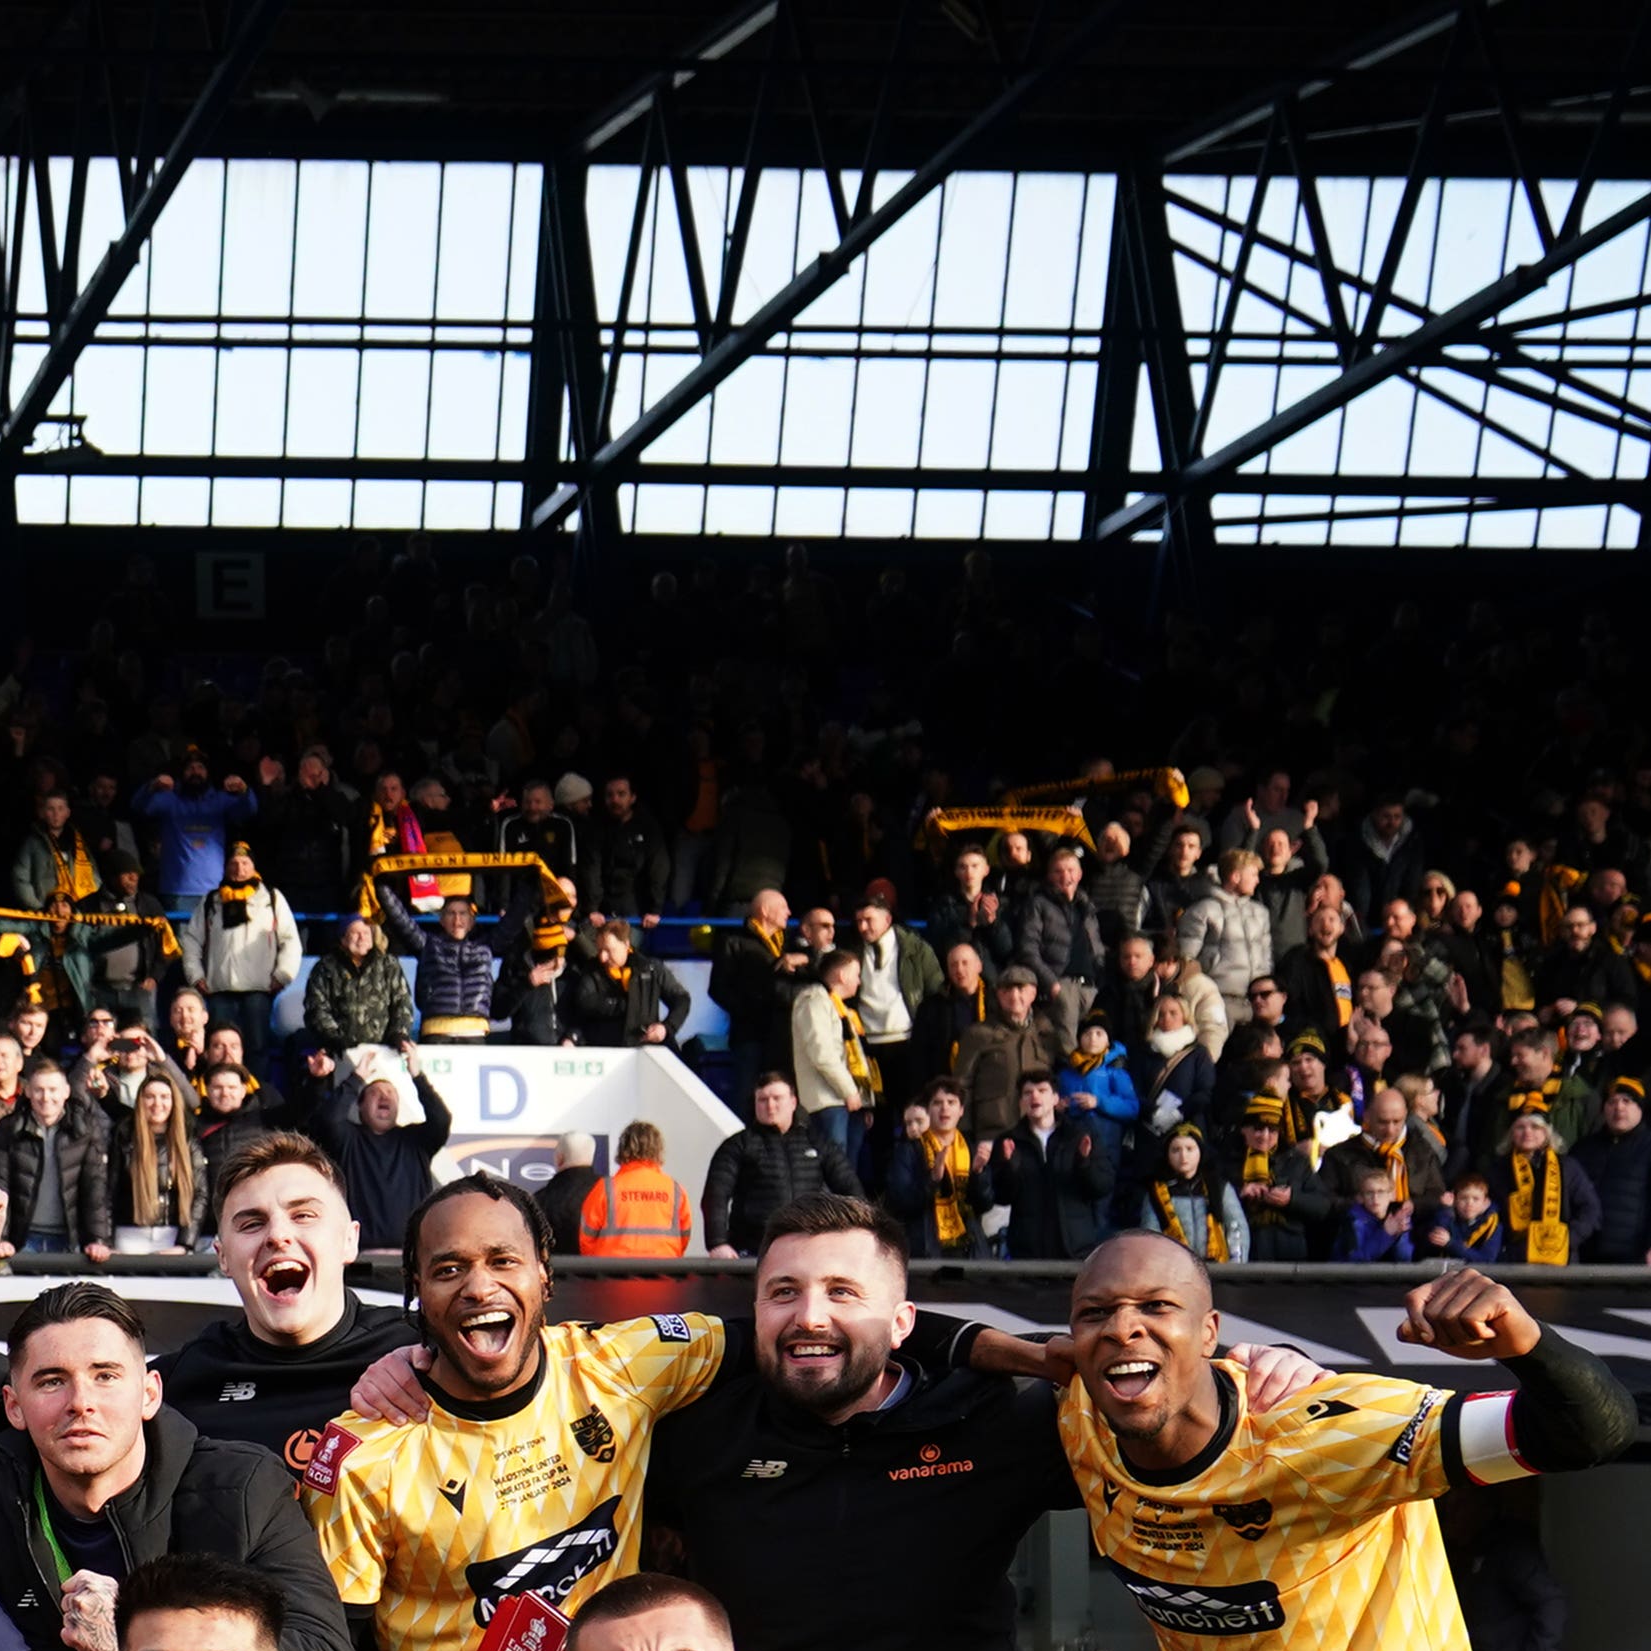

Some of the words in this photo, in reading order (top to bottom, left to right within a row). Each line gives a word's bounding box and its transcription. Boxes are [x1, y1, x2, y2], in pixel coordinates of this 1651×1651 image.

[213, 559, 251, 610] E
[478, 1064, 528, 1121] D
[620, 1190, 669, 1204] STEWARD
[889, 1460, 974, 1481] vanarama
[1150, 1602, 1274, 1628] anchett
